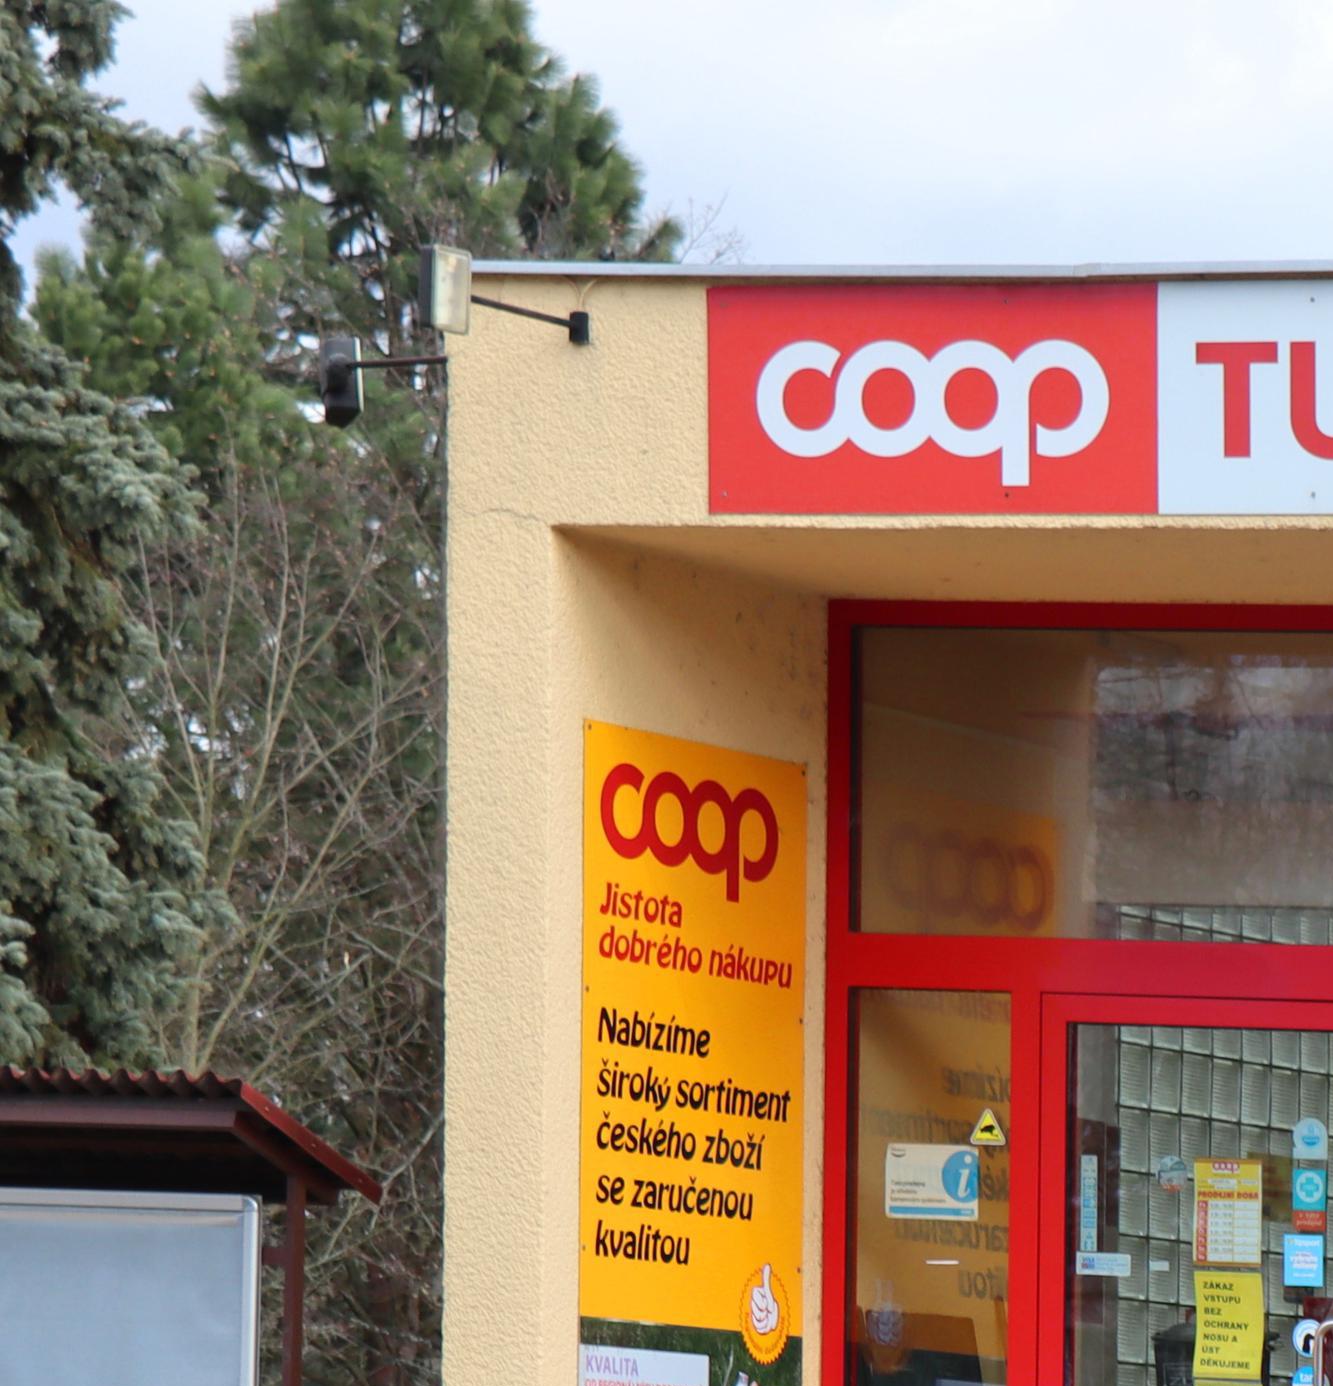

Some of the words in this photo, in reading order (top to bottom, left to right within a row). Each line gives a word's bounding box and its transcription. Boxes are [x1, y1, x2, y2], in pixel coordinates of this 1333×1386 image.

[756, 340, 1109, 486] coop
[600, 763, 778, 903] coop
[599, 882, 683, 928] Jistota
[599, 925, 703, 974] dobrého
[708, 944, 792, 989] nákupu
[597, 1006, 711, 1058] Nabízíme
[597, 1058, 671, 1112] široký
[675, 1078, 791, 1123] sortiment
[596, 1111, 697, 1161] českého
[702, 1128, 766, 1170] zboží
[596, 1174, 625, 1205] se
[630, 1176, 753, 1221] zaručenou
[595, 1219, 690, 1265] kvalitou
[1203, 1281, 1234, 1291] ZÁKAZ
[1203, 1294, 1241, 1305] VSTUPU
[1204, 1307, 1222, 1316] BEZ
[1204, 1320, 1249, 1331] OCHRANY
[1203, 1333, 1229, 1342] NOSU
[585, 1354, 639, 1377] KVALITA
